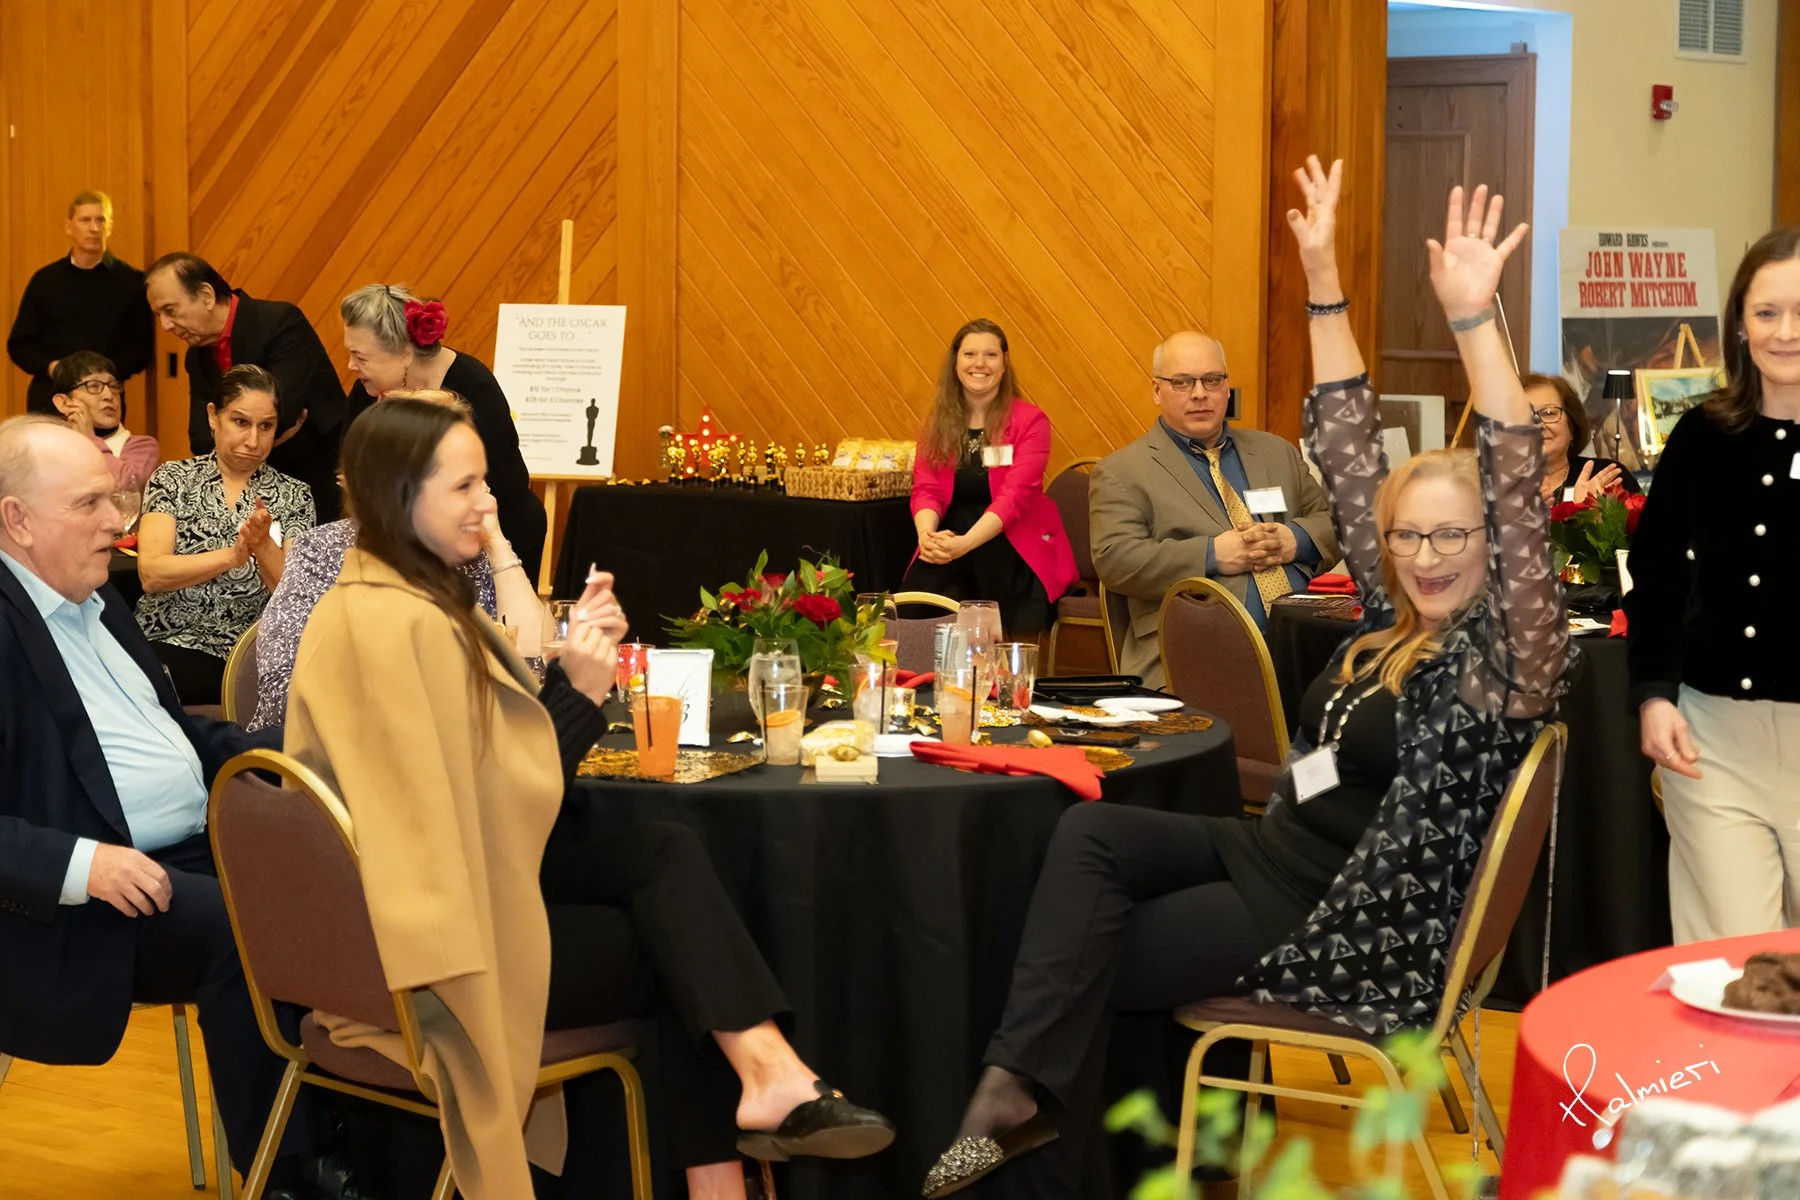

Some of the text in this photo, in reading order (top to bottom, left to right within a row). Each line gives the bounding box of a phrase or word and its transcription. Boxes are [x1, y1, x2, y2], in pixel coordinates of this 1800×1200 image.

[1626, 233, 1649, 247] HAWKS
[1585, 251, 1687, 278] JOHN WAYNE
[1578, 281, 1698, 308] ROBERT MITCHUM
[547, 317, 568, 328] THE
[569, 318, 608, 328] OSCAR
[528, 330, 557, 341] GOES
